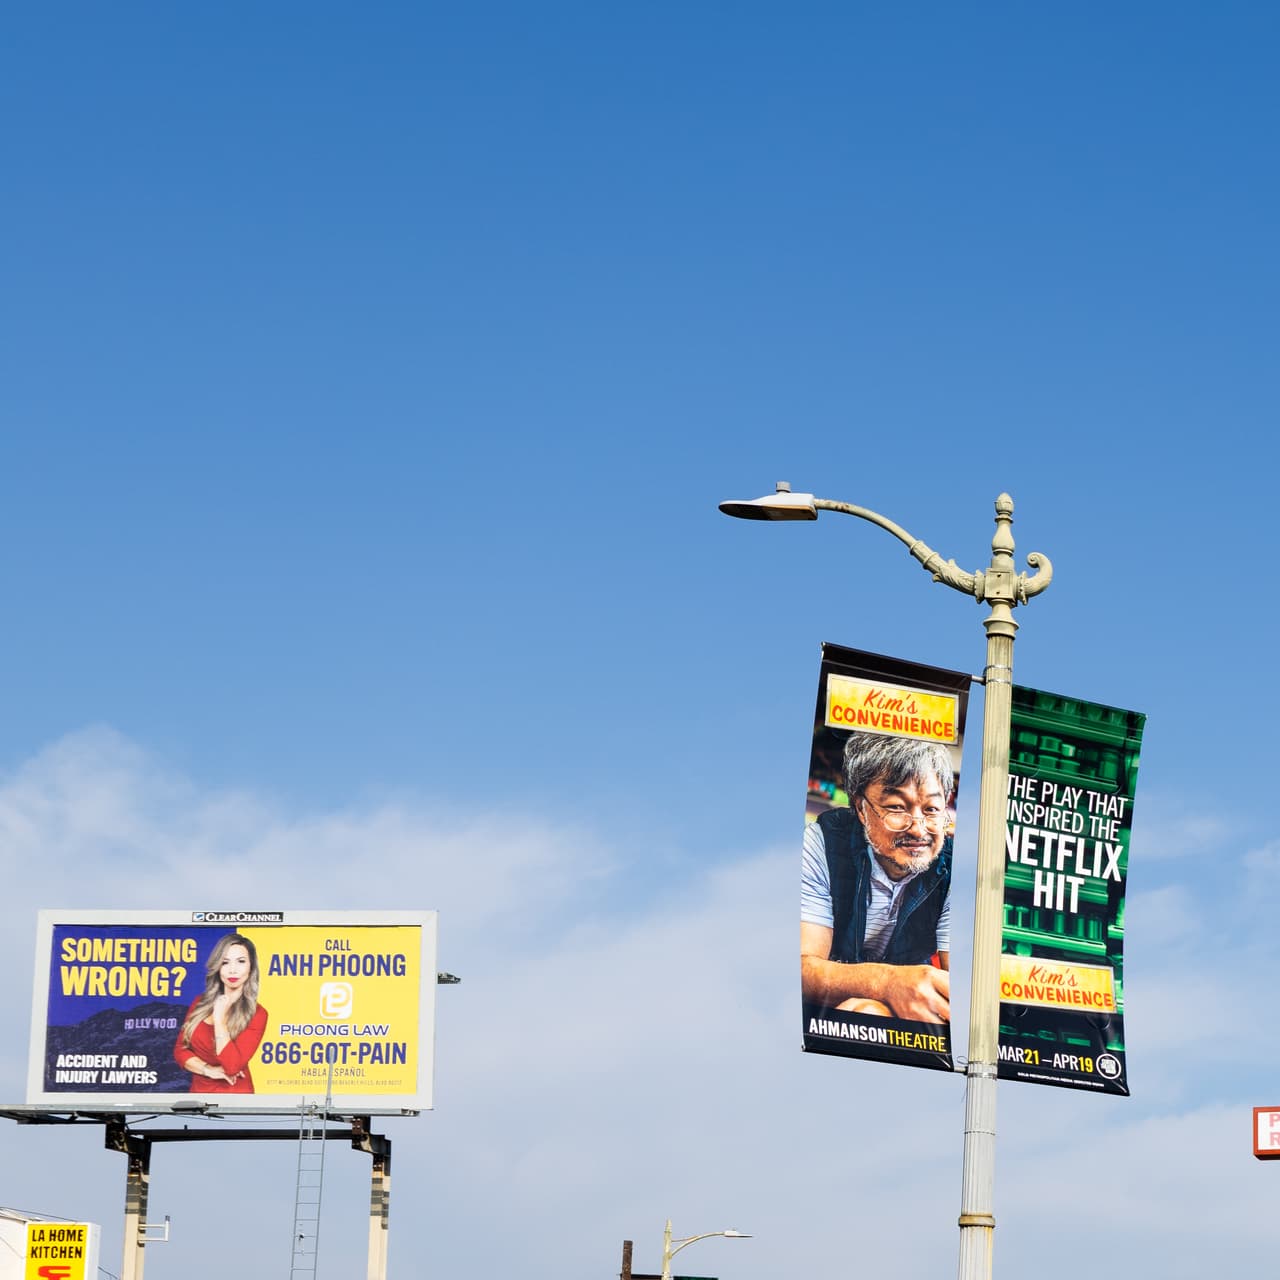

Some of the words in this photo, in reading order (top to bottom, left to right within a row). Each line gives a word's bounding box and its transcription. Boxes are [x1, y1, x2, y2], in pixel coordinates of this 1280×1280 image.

[863, 687, 919, 715] Kim's
[831, 704, 954, 738] CONVENIENCE
[1006, 774, 1038, 801] THE
[1041, 781, 1084, 810] PLAY
[1087, 790, 1129, 819] THAT
[1006, 799, 1084, 834] INSPIRED
[1089, 815, 1122, 842] THE
[1006, 823, 1124, 882] NETFLIX
[1033, 869, 1086, 914] HIT
[60, 937, 198, 963] SOMETHING
[325, 939, 352, 951] CALL
[268, 954, 313, 976] ANH
[318, 953, 407, 977] PHOONG
[1028, 965, 1079, 987] Kim's
[60, 965, 188, 997] WRONG?
[1000, 981, 1113, 1007] CONVENIENCE
[280, 1024, 349, 1036] PHOONG
[353, 1024, 390, 1036] LAW
[56, 1054, 119, 1069] ACCIDENT
[120, 1055, 148, 1069] AND
[261, 1041, 407, 1065] 866-GOT-PAIN
[55, 1070, 99, 1084] INJURY
[101, 1070, 158, 1085] LAWYERS
[301, 1068, 327, 1077] HABLA
[332, 1066, 367, 1077] SPAÑOL
[32, 1229, 45, 1242] LA
[49, 1228, 84, 1242] HOME
[31, 1245, 83, 1259] KITCHEN
